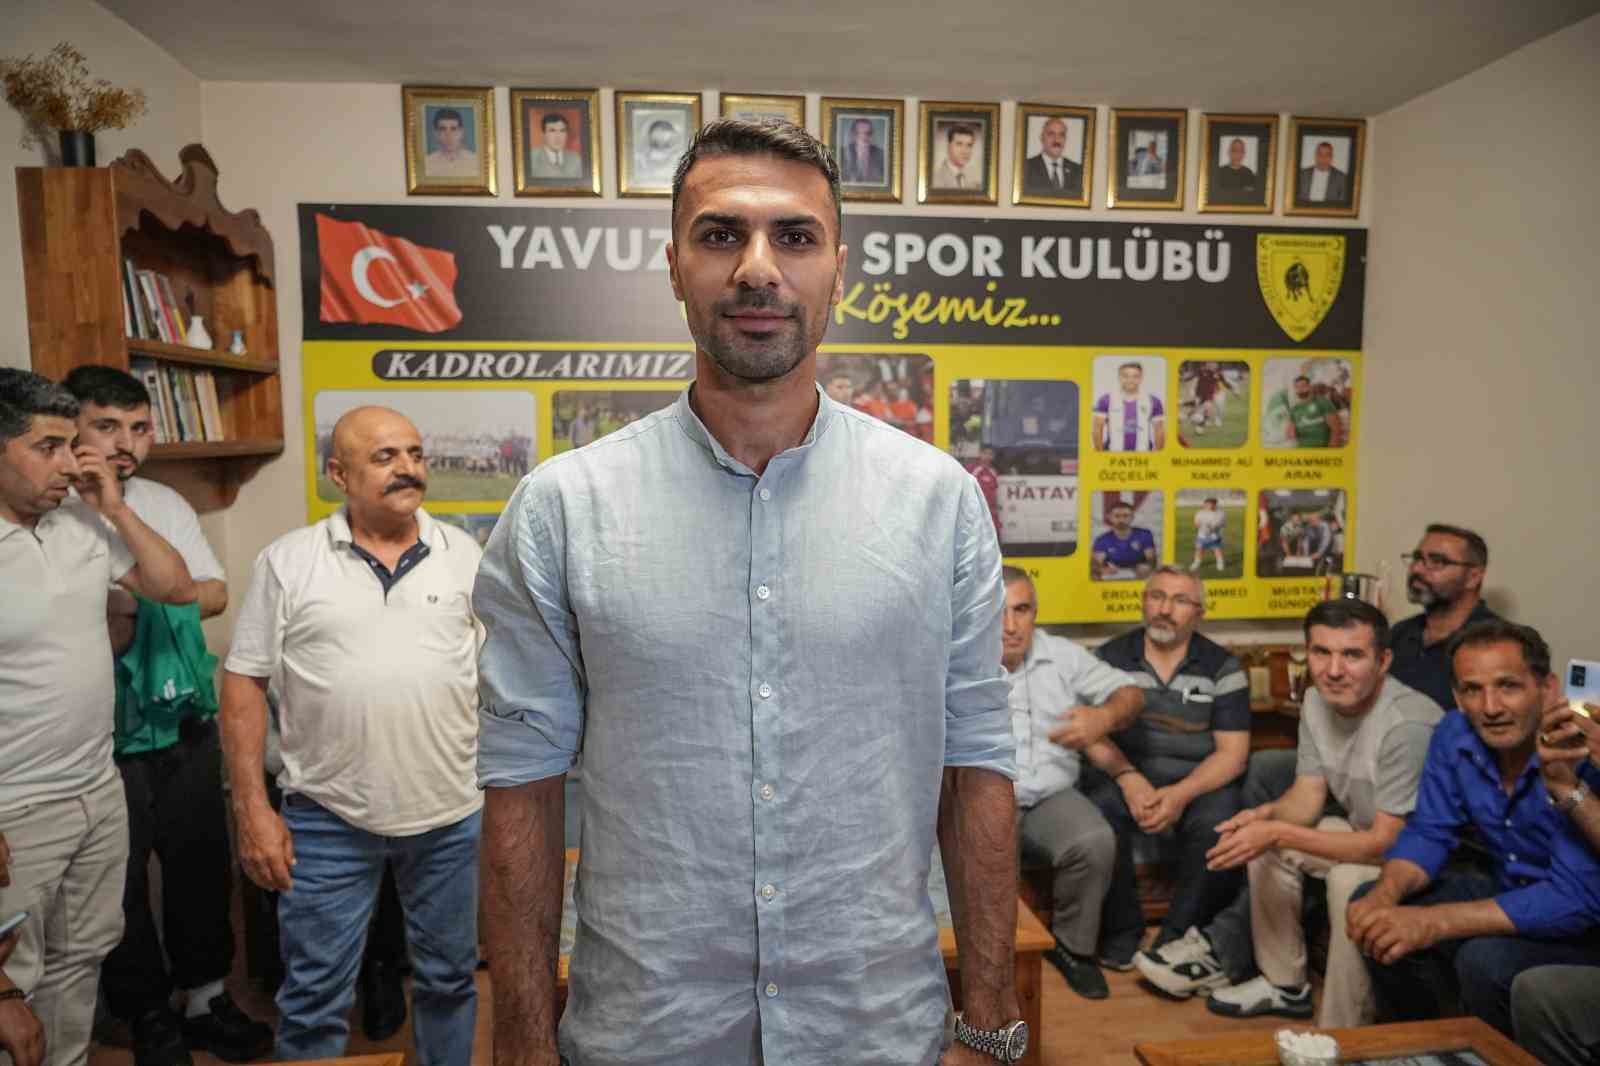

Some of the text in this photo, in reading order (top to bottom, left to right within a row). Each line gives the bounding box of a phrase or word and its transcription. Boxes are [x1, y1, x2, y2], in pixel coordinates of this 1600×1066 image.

[486, 225, 672, 271] YAVUZ
[862, 232, 1004, 277] SPOR
[1020, 227, 1231, 283] KULÜBÜ
[384, 352, 692, 378] KADROLARIMIZ
[1264, 456, 1344, 467] MUHAMMED
[1284, 469, 1322, 481] ARAN
[1006, 486, 1076, 500] HATAY
[1101, 588, 1139, 600] ERDA
